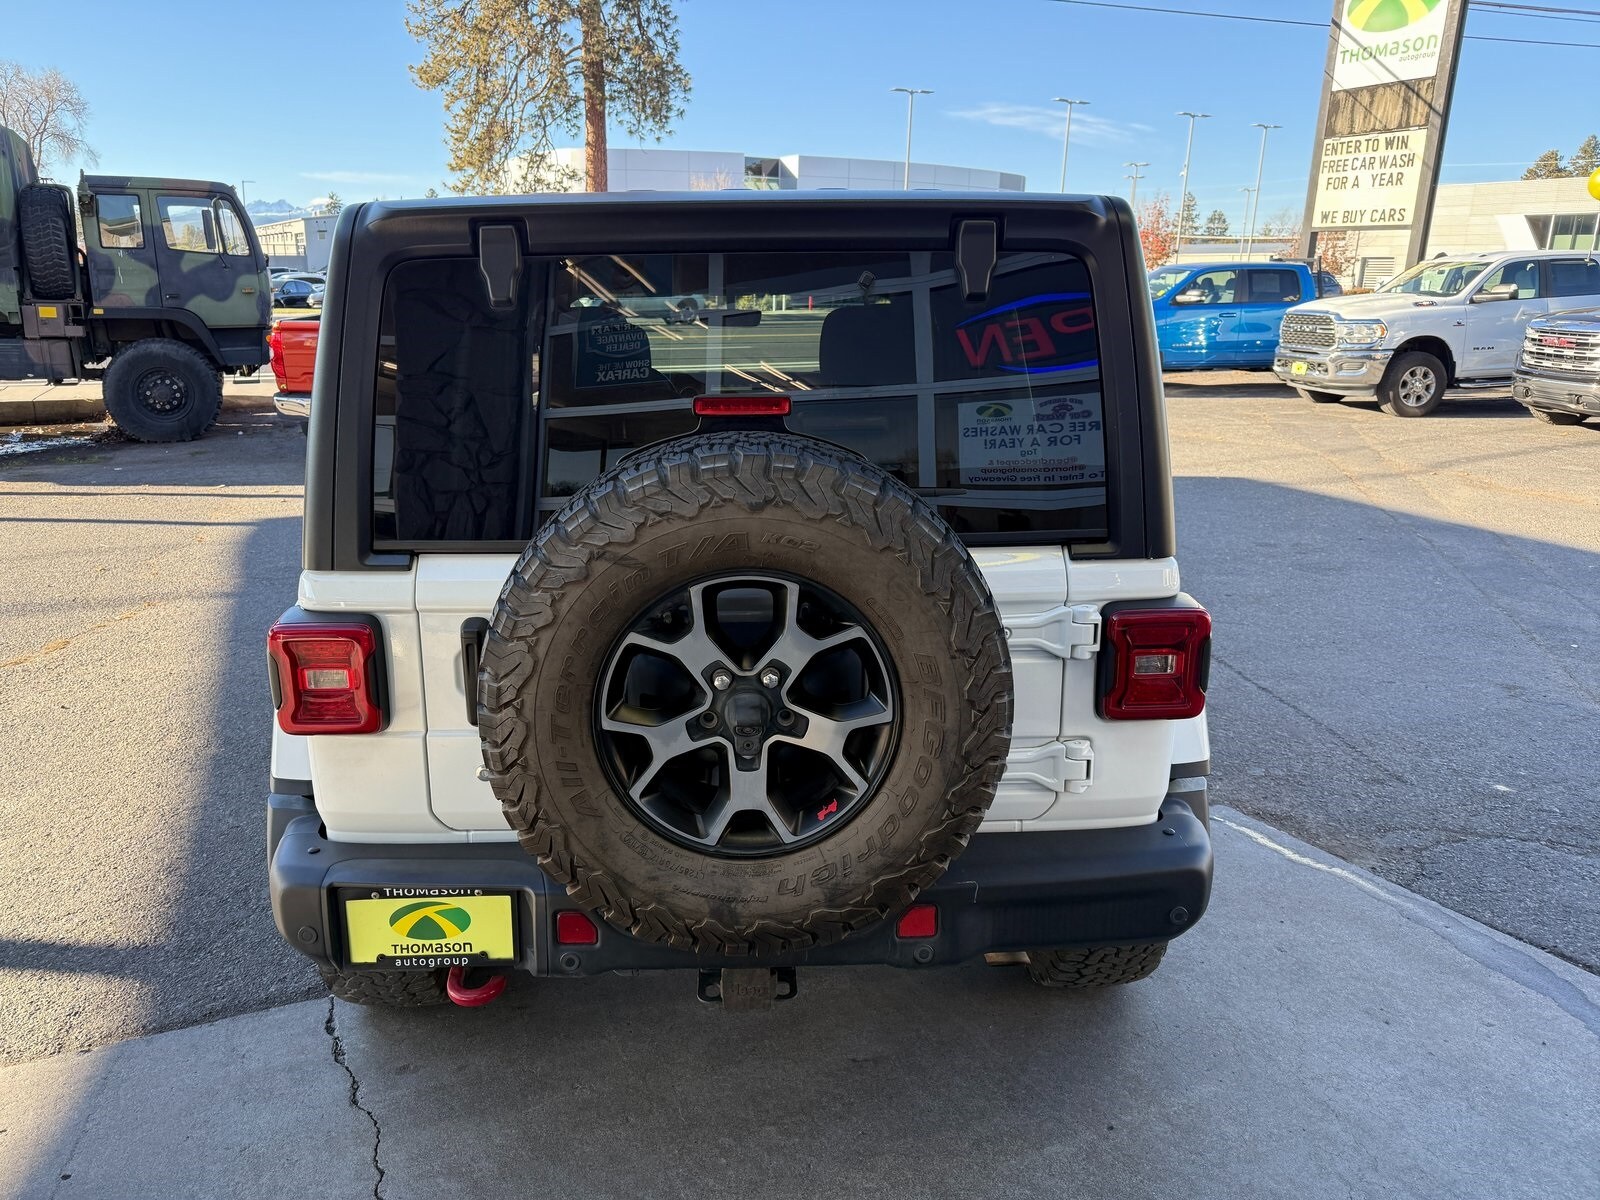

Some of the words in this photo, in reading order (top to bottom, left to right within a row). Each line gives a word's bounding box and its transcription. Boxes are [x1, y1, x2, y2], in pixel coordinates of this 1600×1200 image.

[1399, 51, 1436, 62] autogroup
[1324, 140, 1362, 156] ENTER
[1365, 138, 1379, 152] TO
[1384, 135, 1409, 150] WIN
[1321, 159, 1349, 174] FREE
[1351, 156, 1375, 171] CAR
[1378, 152, 1415, 168] WASH
[1326, 177, 1347, 190] FOR
[1351, 175, 1360, 189] A
[1371, 172, 1404, 188] YEAR
[1320, 211, 1337, 224] WE
[1342, 209, 1367, 223] BUY
[1370, 208, 1406, 222] CARS
[656, 531, 750, 568] T/A
[395, 956, 469, 967] autogroup
